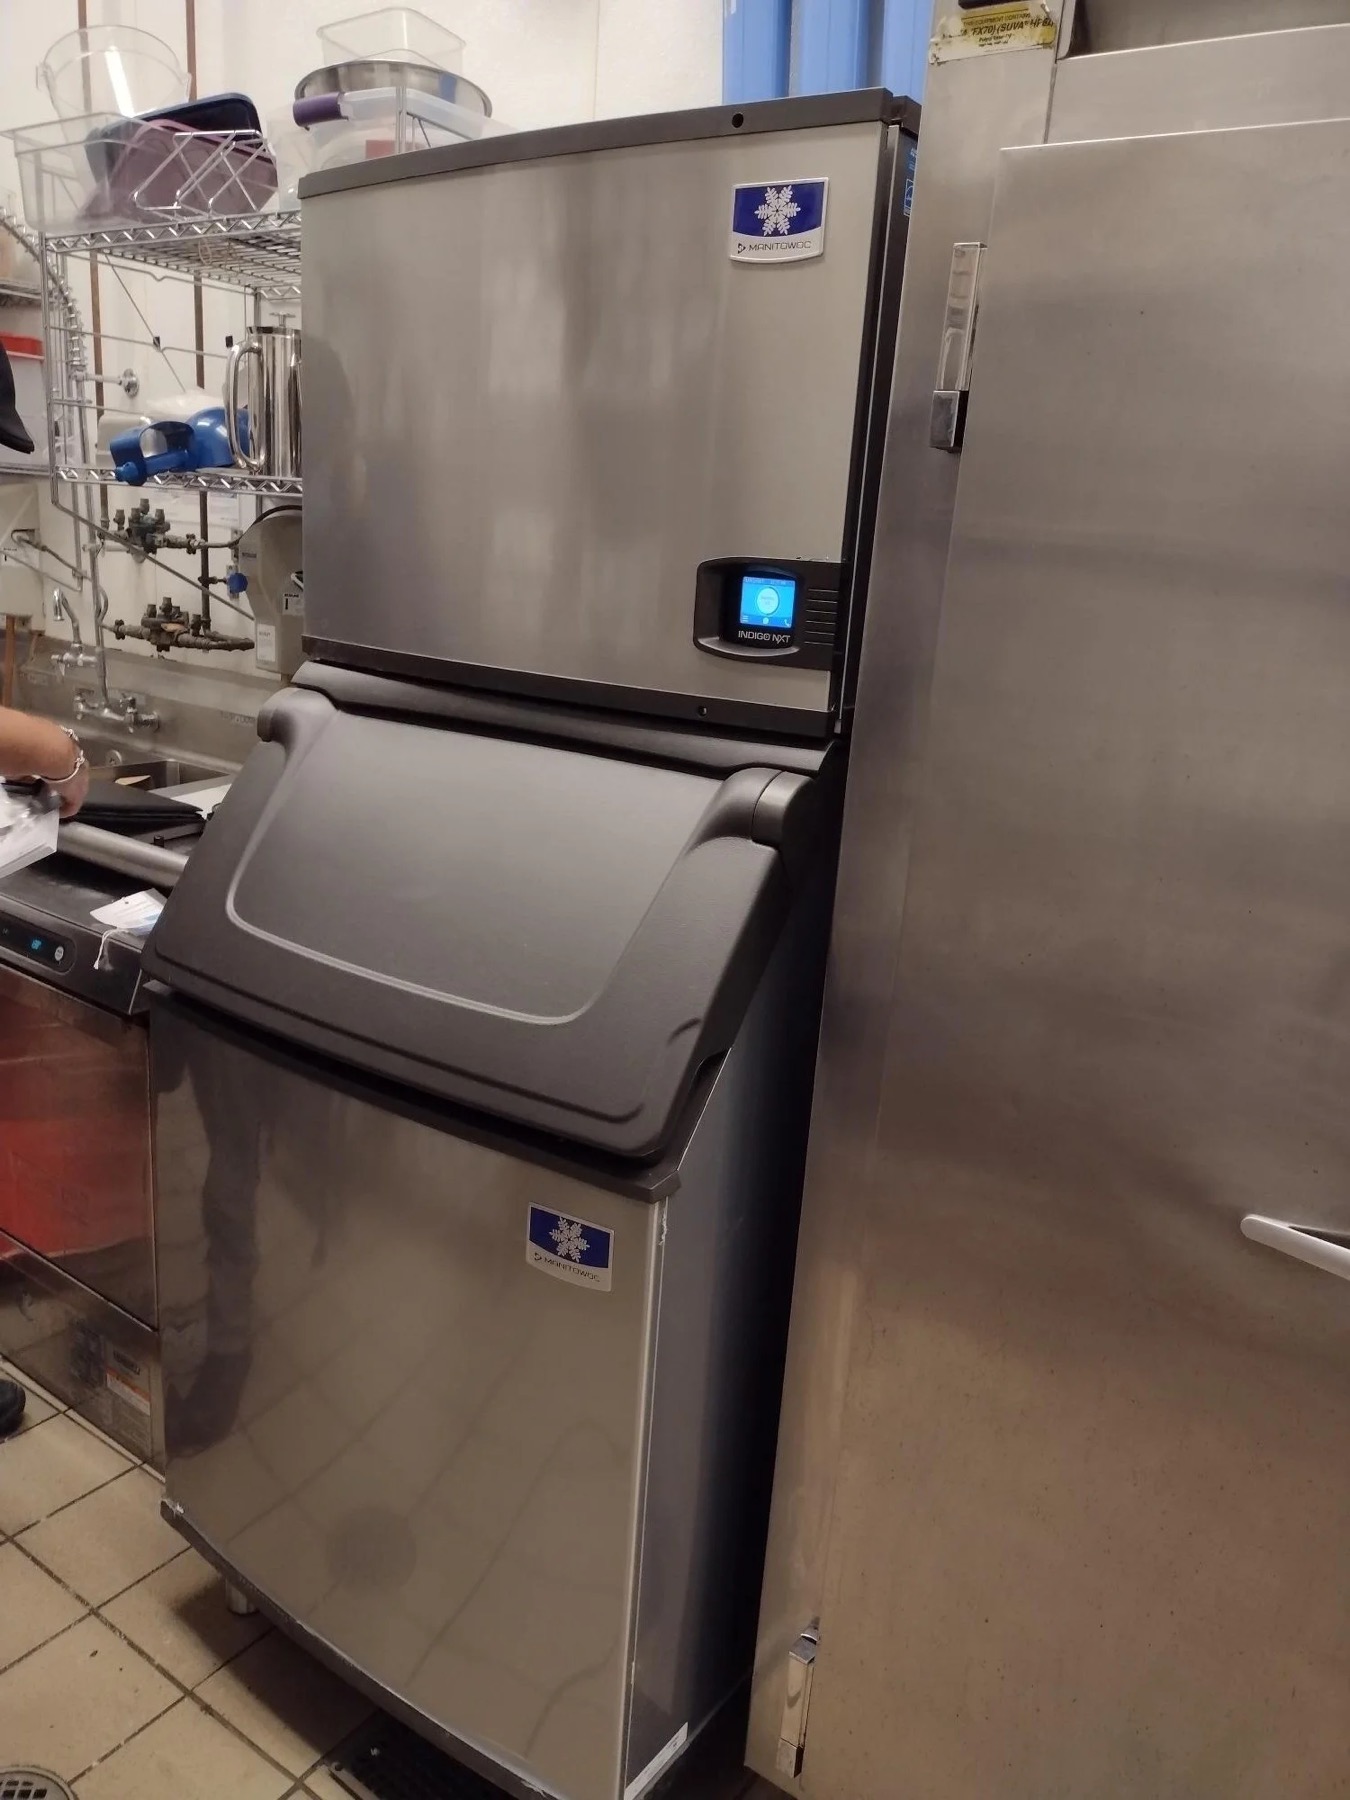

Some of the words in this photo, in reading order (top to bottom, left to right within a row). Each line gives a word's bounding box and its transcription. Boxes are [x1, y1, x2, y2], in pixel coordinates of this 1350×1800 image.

[748, 240, 812, 252] MANITOWOC
[738, 630, 771, 641] INDIGO
[772, 634, 791, 644] NXT
[544, 1256, 601, 1283] MANITOWOC
